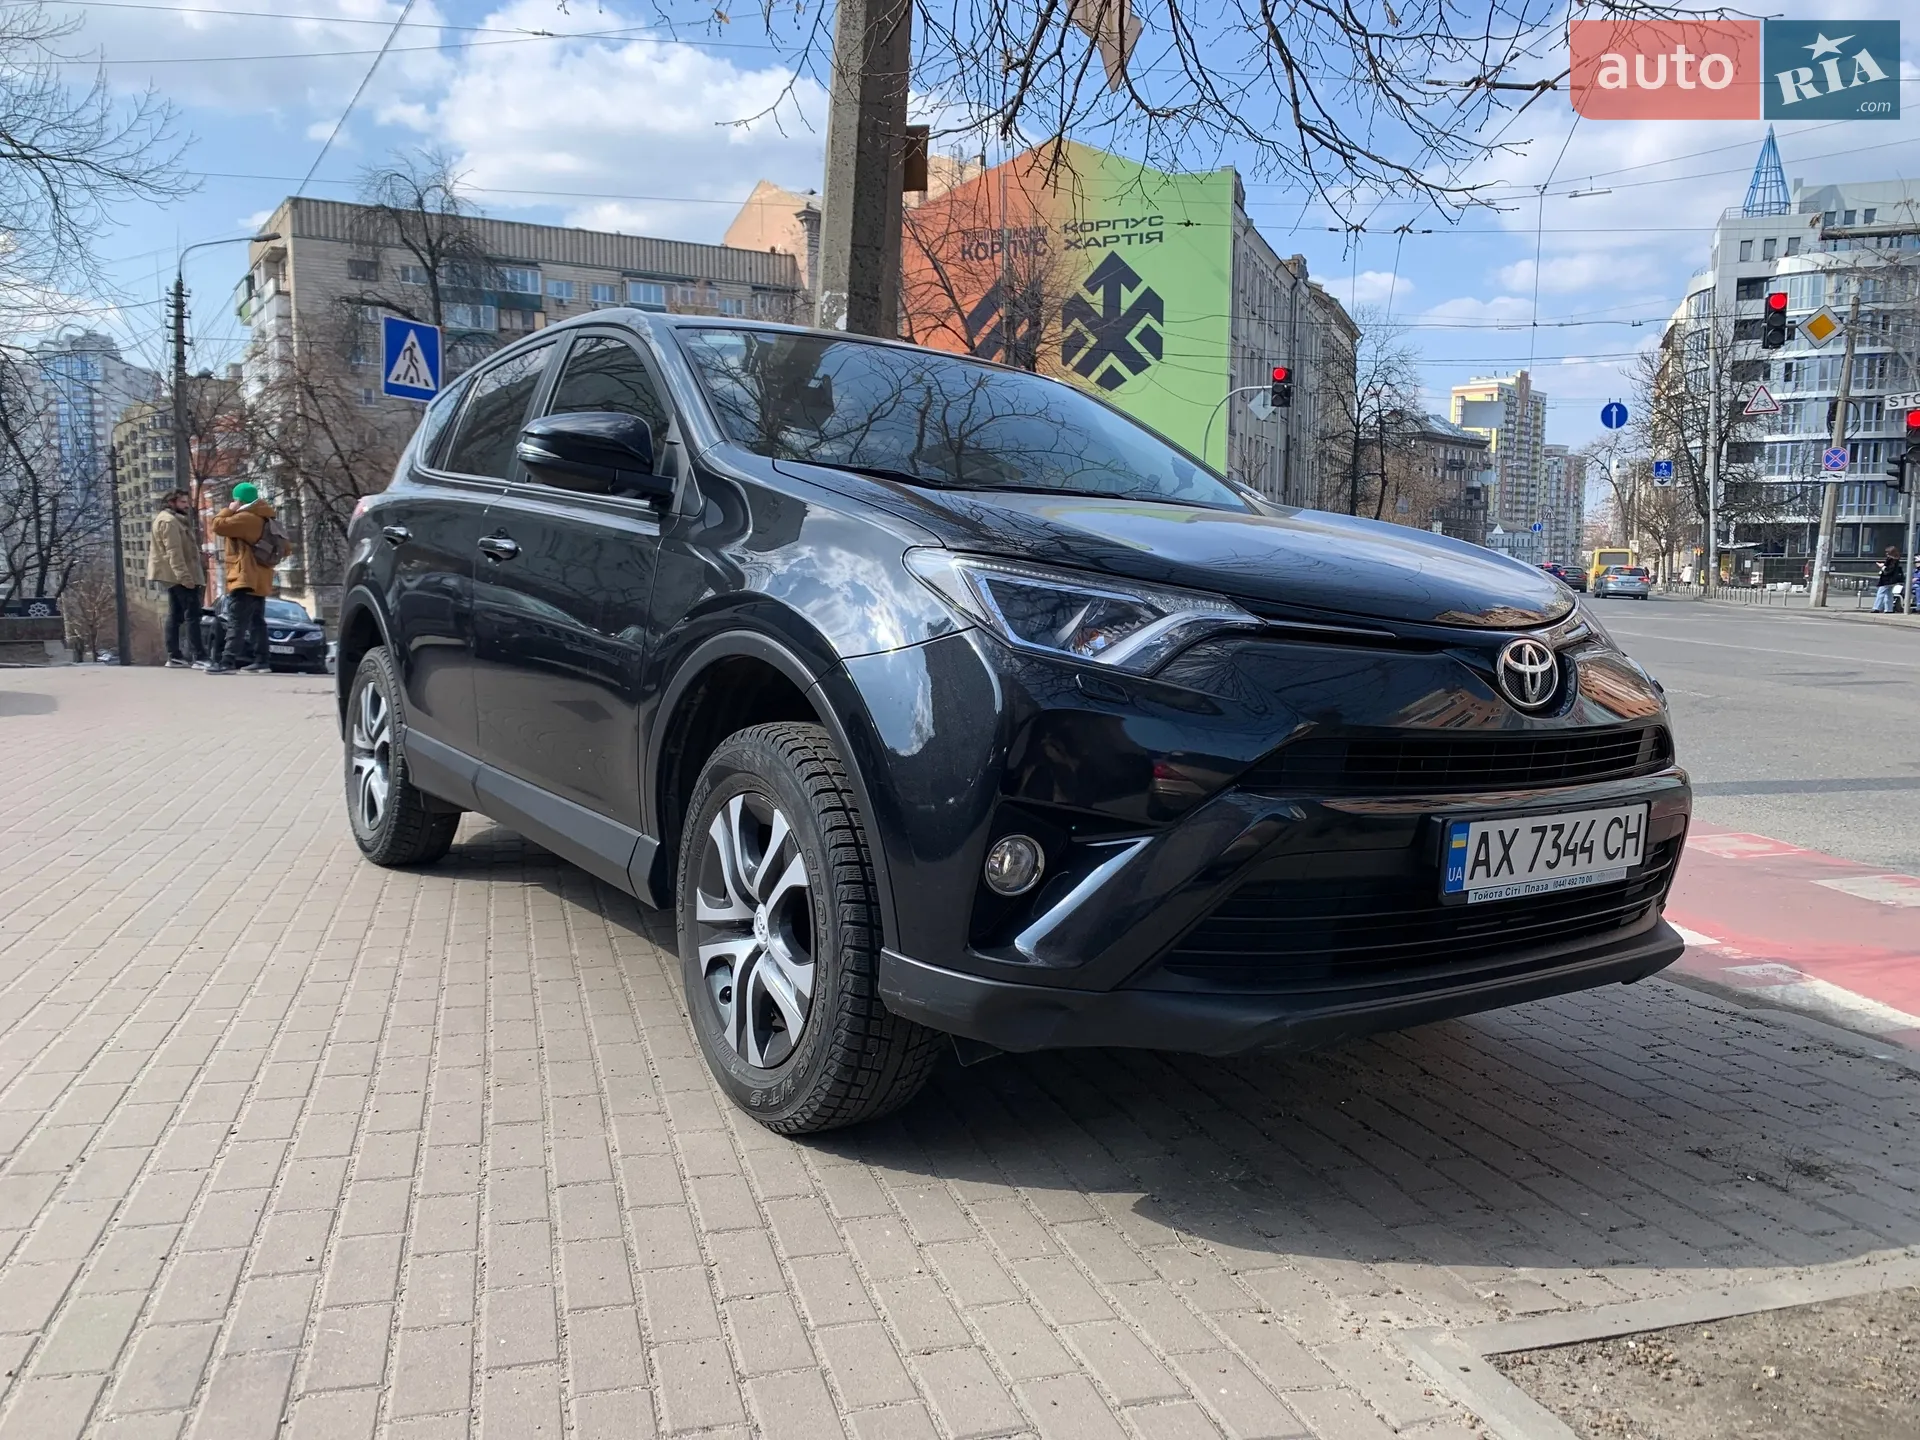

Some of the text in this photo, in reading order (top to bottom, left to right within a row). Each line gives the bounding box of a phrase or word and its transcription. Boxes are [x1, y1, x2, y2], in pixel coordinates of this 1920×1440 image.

[1063, 215, 1164, 234] КОРПУС
[1064, 231, 1164, 250] ХАРТІЯ
[1469, 813, 1643, 880] AX 7344 CH
[1449, 867, 1463, 882] UA
[1473, 889, 1503, 901] Тойота
[1505, 886, 1521, 896] Сіті
[1524, 883, 1549, 894] Плаза
